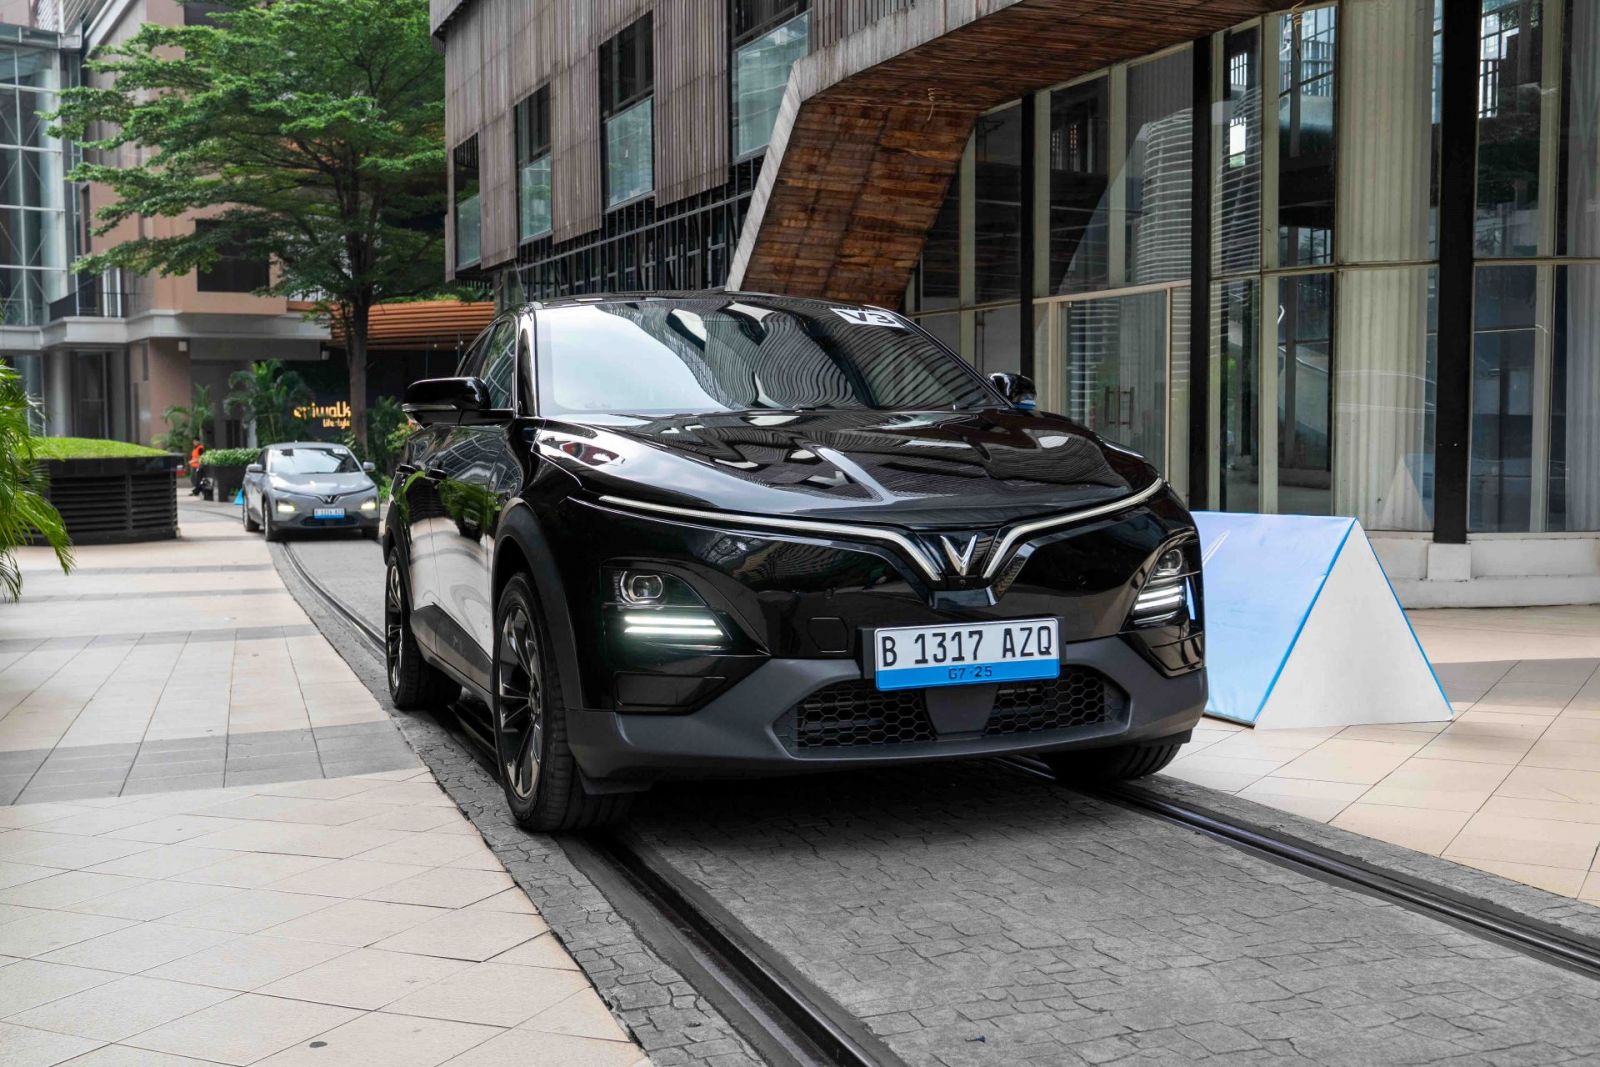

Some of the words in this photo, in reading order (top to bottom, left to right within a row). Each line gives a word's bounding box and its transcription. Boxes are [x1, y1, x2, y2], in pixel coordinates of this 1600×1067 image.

[881, 636, 897, 667] B
[914, 630, 984, 664] 1317
[1002, 625, 1053, 658] AZQ
